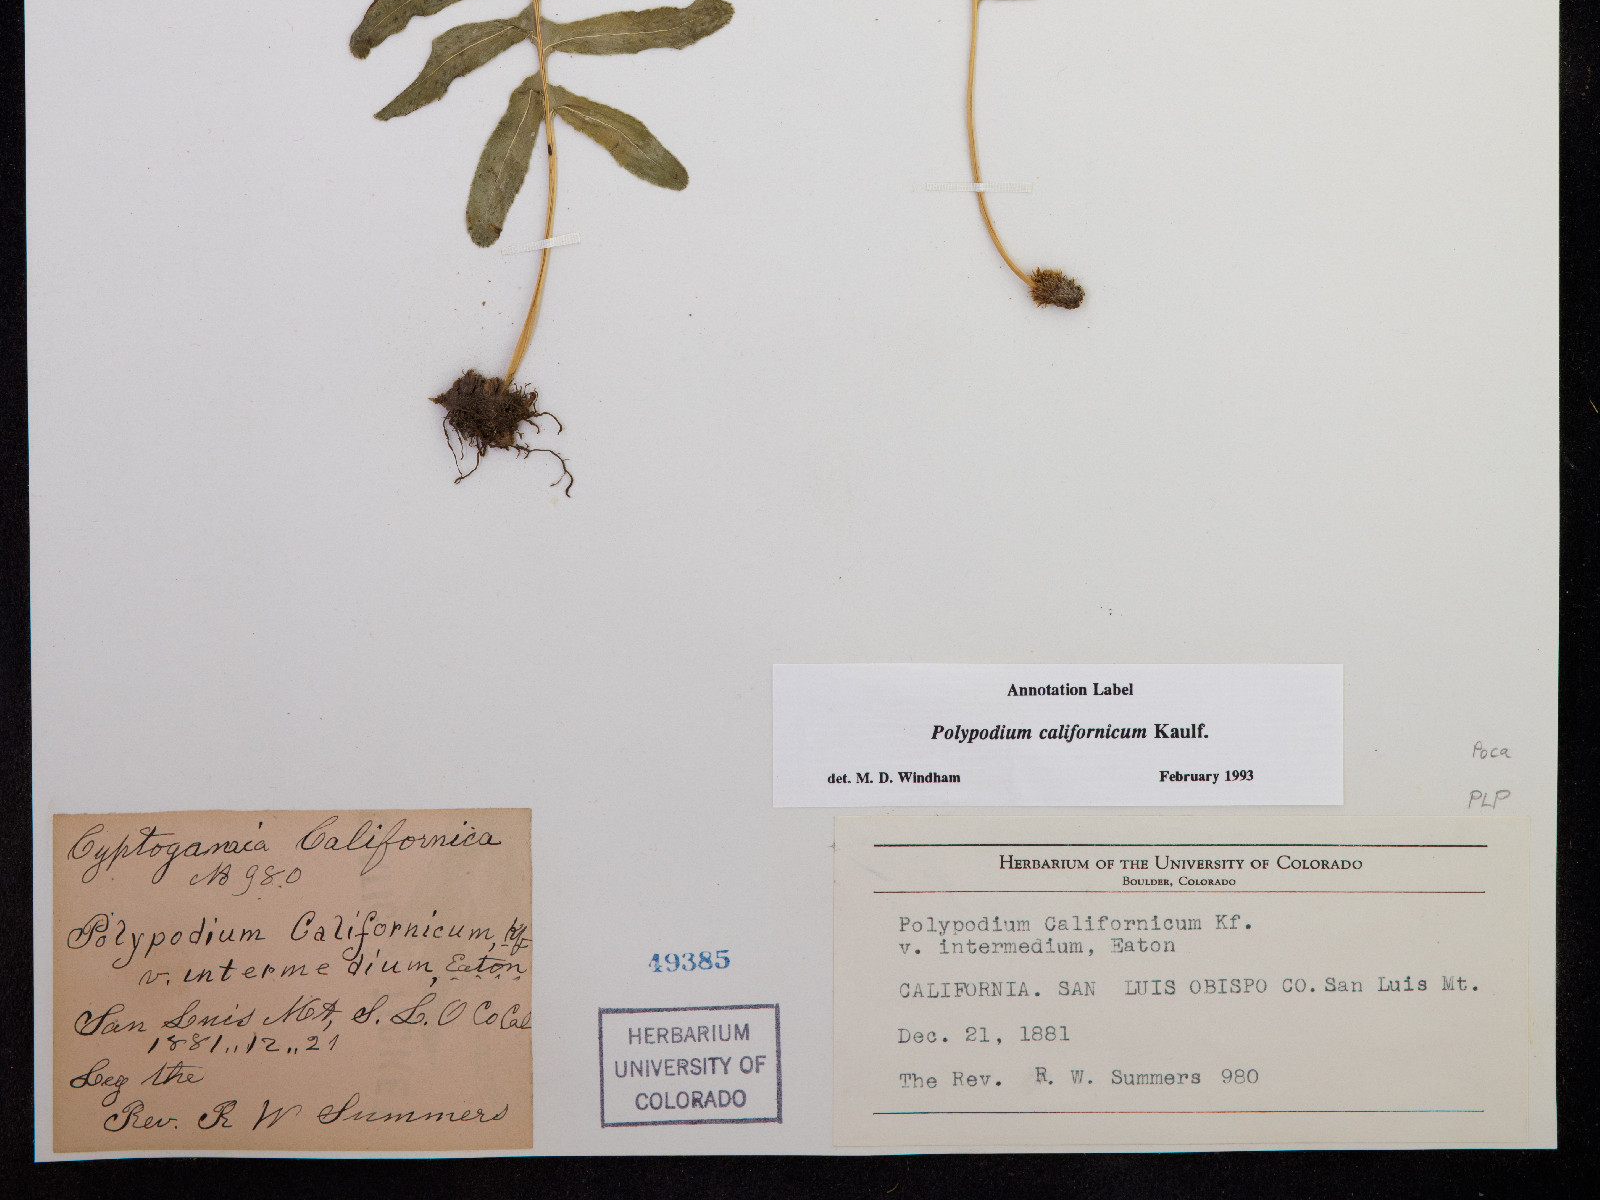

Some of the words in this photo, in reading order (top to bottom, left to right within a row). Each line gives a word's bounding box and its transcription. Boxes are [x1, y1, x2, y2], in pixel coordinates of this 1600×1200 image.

[1007, 682, 1088, 697] Annotation
[1093, 682, 1134, 696] Label
[931, 724, 1032, 744] Polypodium
[1038, 723, 1147, 744] californicum
[1154, 723, 1209, 739] Kaulf.
[827, 772, 851, 784] det.
[856, 772, 874, 784] M.
[878, 772, 893, 784] D.
[898, 771, 961, 784] Windham
[1159, 770, 1219, 785] February
[1224, 769, 1254, 782] 1993
[1468, 789, 1511, 810] PLP
[1000, 854, 1090, 871] HERBARIUM
[1096, 859, 1114, 871] OF
[1120, 859, 1149, 871] THE
[1155, 855, 1244, 872] UNIVERSITY
[1250, 858, 1269, 871] OF
[1276, 854, 1363, 871] COLORADO
[1178, 876, 1236, 887] COLORADO
[899, 916, 1031, 935] Polypodium
[1044, 915, 1202, 932] Californicum
[1215, 914, 1252, 930] Kf.
[67, 912, 266, 969] Polypodium
[900, 943, 921, 955] v.
[939, 938, 1095, 956] intermedium,
[1110, 937, 1176, 953] Eaton
[649, 949, 731, 973] 49385
[899, 982, 1041, 998] CALIFORNIA.
[1058, 981, 1097, 996] SAN
[1124, 979, 1177, 996] LUIS
[1189, 978, 1268, 995] OBISPO
[1281, 977, 1316, 993] CO.
[1324, 976, 1364, 993] San
[1377, 976, 1428, 992] Luis
[1441, 975, 1479, 992] Mt.
[628, 1023, 751, 1045] HERBARIUM
[898, 1028, 949, 1044] Dec.
[964, 1026, 1003, 1046] 21,
[1019, 1025, 1071, 1042] 1881
[614, 1057, 732, 1078] UNIVERSITY
[739, 1055, 767, 1074] OF
[899, 1072, 938, 1088] The
[952, 1070, 1002, 1087] Rev.
[1034, 1066, 1054, 1086] R.
[1070, 1069, 1094, 1085] W.
[1111, 1069, 1201, 1086] Summers
[1220, 1068, 1259, 1084] 980
[635, 1089, 747, 1111] COLORADO
[103, 1100, 179, 1133] Rev.
[252, 1099, 303, 1131] W
[316, 1092, 509, 1125] Summers
